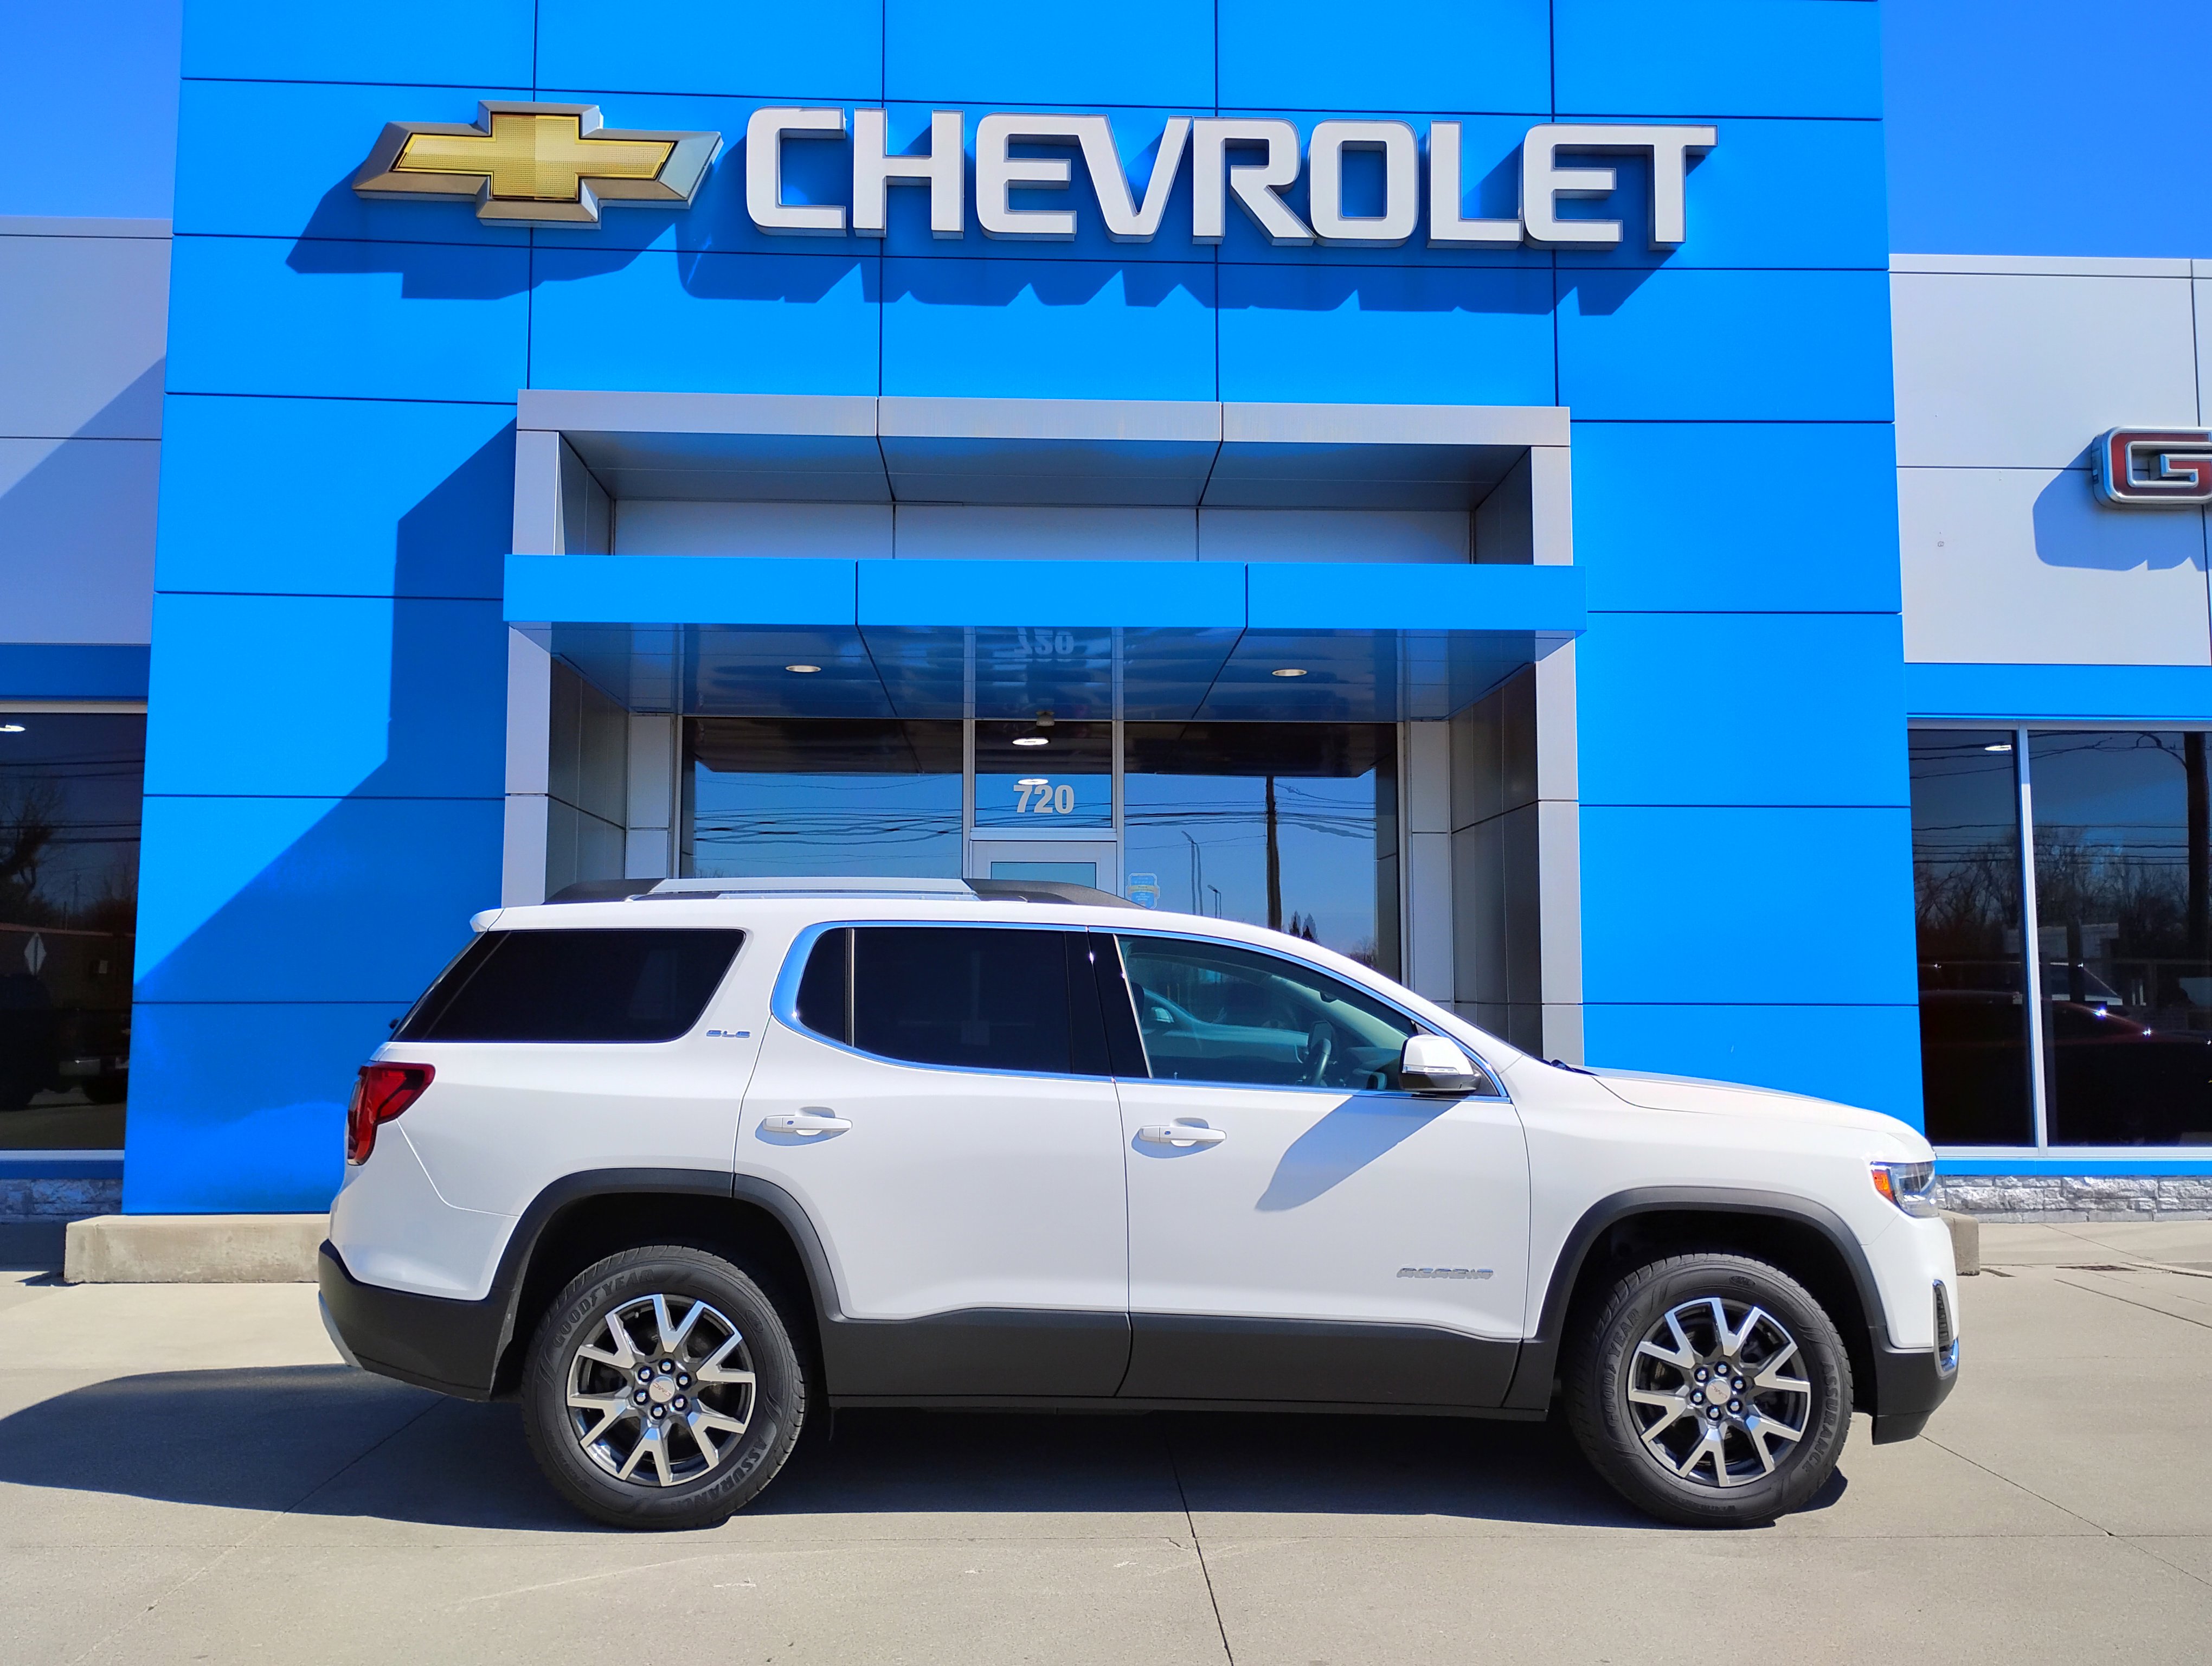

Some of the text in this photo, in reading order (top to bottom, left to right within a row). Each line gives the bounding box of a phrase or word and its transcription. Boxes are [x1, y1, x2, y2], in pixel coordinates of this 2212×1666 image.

[746, 108, 1717, 249] CHEVROLET
[1013, 785, 1074, 814] 720
[706, 1029, 750, 1039] SLE
[552, 1269, 654, 1348] GOODYEAR
[653, 1381, 672, 1397] GMC
[1602, 1308, 1642, 1427] GOODYEAR
[1802, 1361, 1840, 1472] ASSURANCE
[671, 1434, 767, 1511] ASSURANCE
